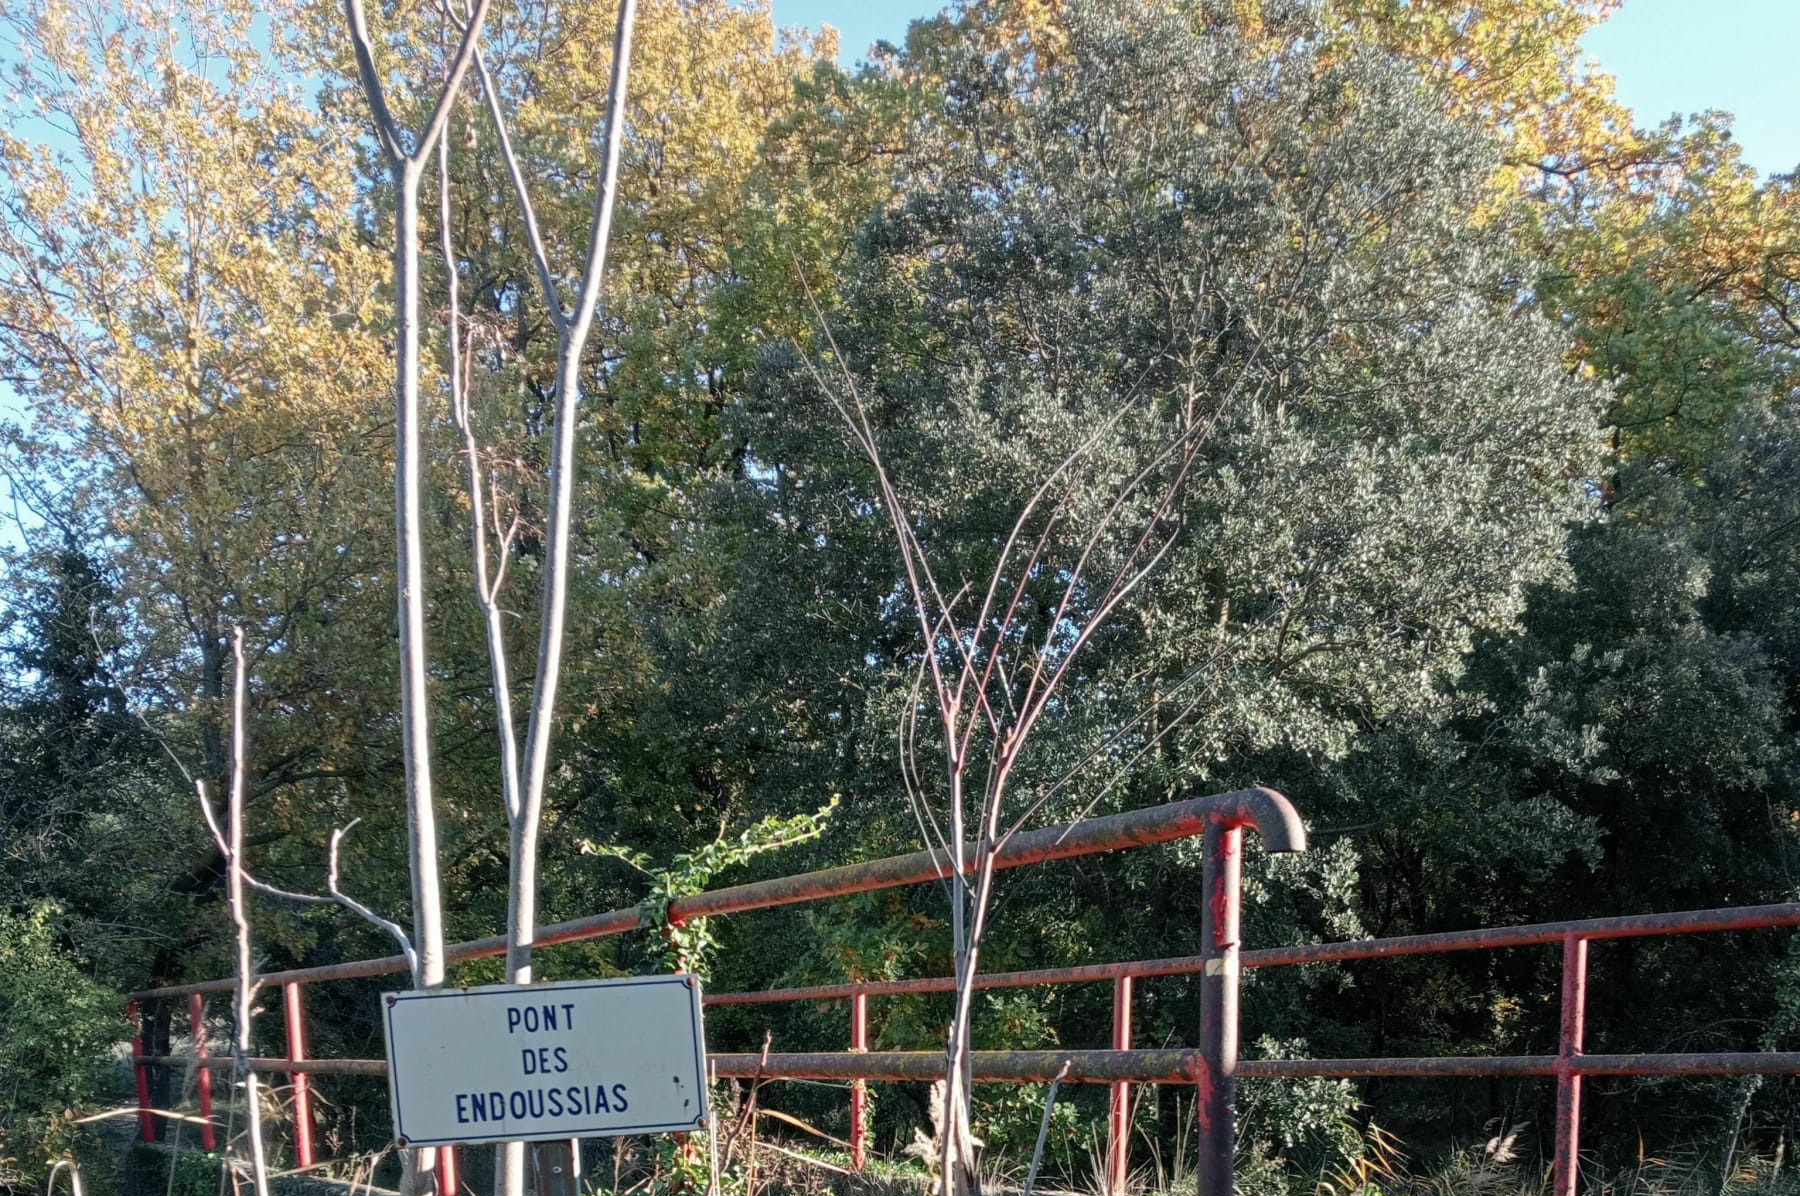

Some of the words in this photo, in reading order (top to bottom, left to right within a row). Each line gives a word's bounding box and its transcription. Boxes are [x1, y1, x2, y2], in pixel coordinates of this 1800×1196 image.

[507, 1004, 575, 1034] PONT
[522, 1047, 568, 1075] DES
[455, 1083, 629, 1123] ENDOUSSIAS
